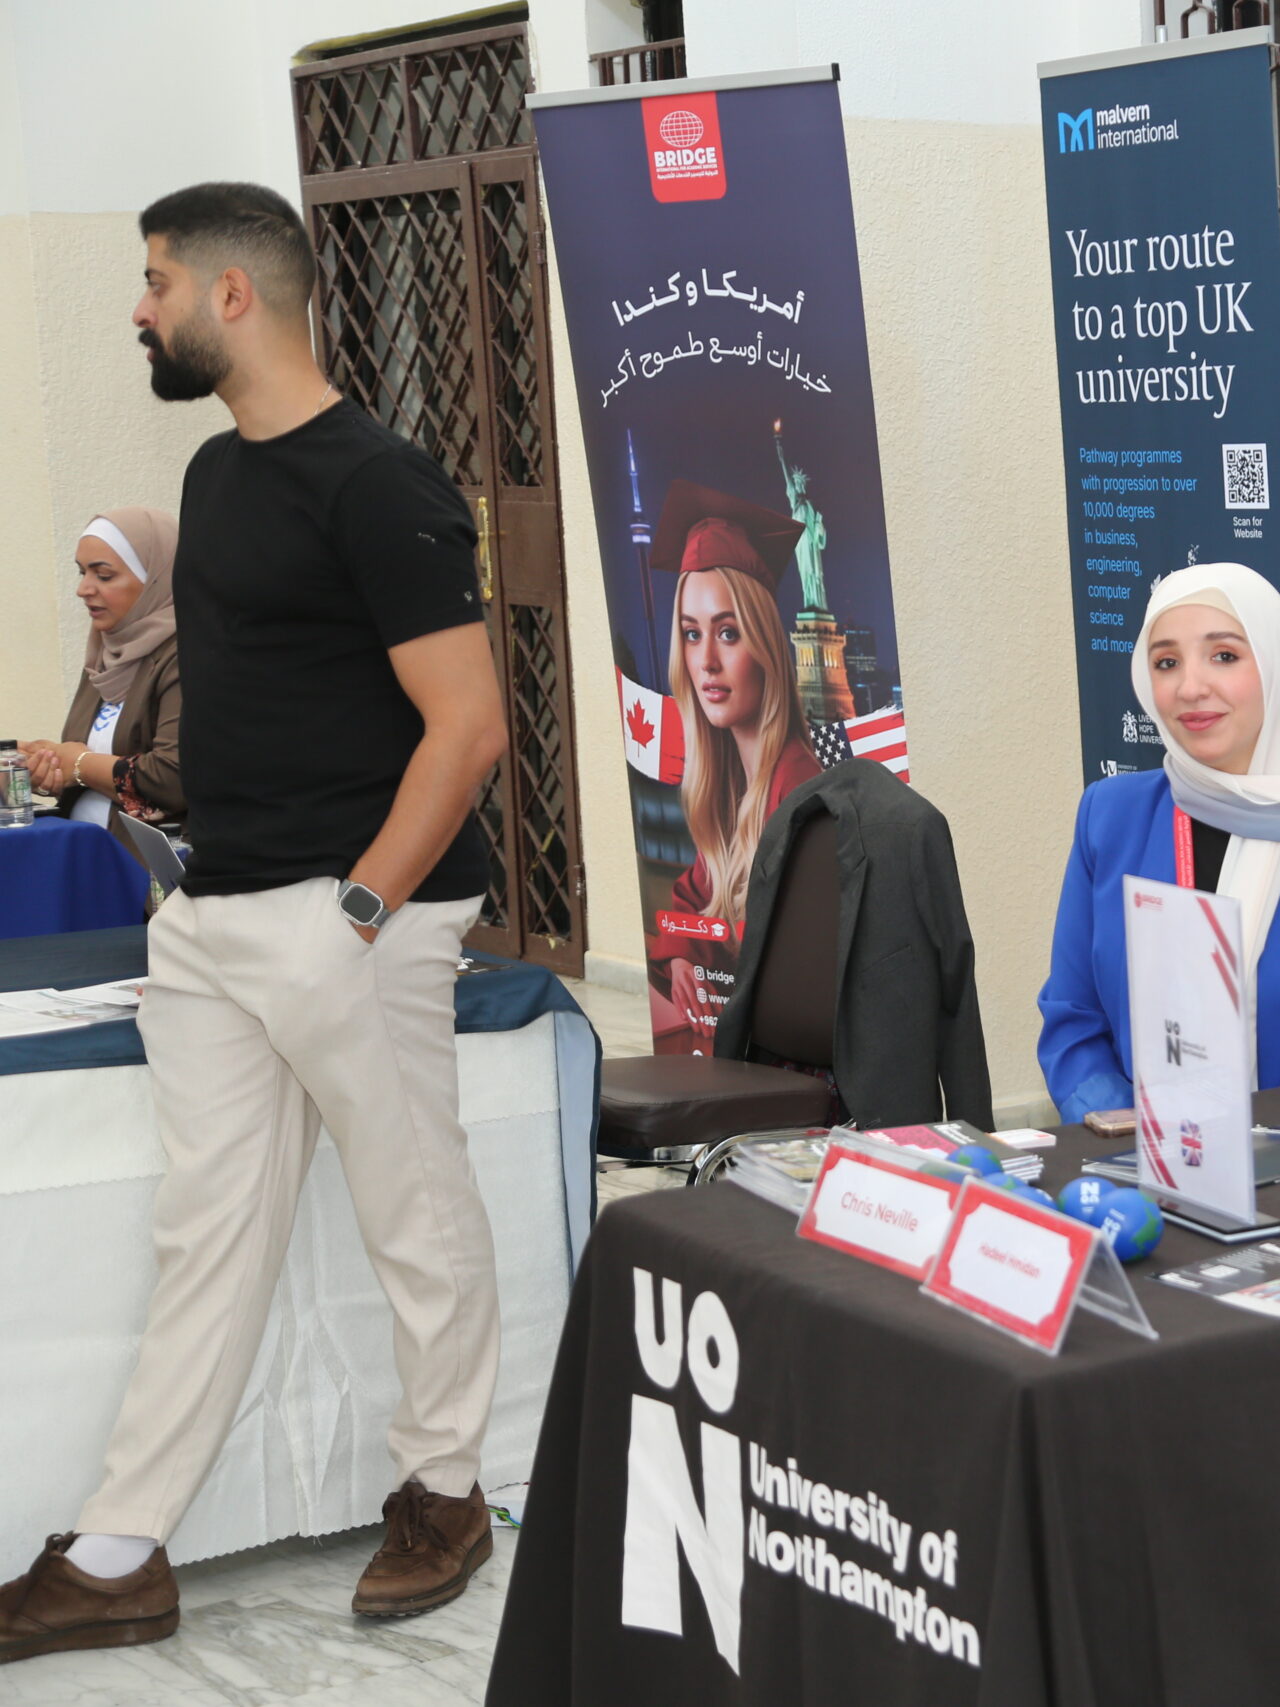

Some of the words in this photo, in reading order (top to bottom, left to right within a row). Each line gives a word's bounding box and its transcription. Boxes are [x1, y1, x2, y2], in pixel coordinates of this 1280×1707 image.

[1096, 104, 1149, 126] malvern
[1097, 120, 1178, 149] international
[654, 147, 717, 167] BRIDGE
[1066, 229, 1137, 277] Your
[1147, 225, 1235, 271] route
[703, 267, 805, 324] أمريكا
[1072, 301, 1102, 340] to
[1110, 304, 1126, 339] a
[1134, 297, 1187, 353] top
[1196, 282, 1254, 334] UK
[639, 331, 704, 378] طموح
[710, 331, 763, 363] أوسع
[601, 349, 637, 408] أكبر
[766, 347, 832, 393] خيارات
[1076, 351, 1235, 419] university
[1080, 448, 1119, 468] Pathway
[1121, 450, 1182, 467] programmes
[1081, 476, 1101, 490] with
[1103, 475, 1158, 493] progression
[1161, 478, 1171, 490] to
[1173, 479, 1197, 491] over
[1083, 501, 1113, 520] 10,000
[1116, 503, 1155, 522] degrees
[1233, 517, 1250, 527] Scan
[1252, 517, 1262, 527] for
[1084, 529, 1093, 543] in
[1095, 530, 1138, 548] business,
[1234, 529, 1263, 539] Website
[1087, 556, 1142, 576] engineering,
[1088, 586, 1131, 602] computer
[1090, 610, 1124, 626] science
[1092, 637, 1108, 651] and
[1111, 641, 1133, 653] more
[1139, 725, 1154, 734] HOPE
[661, 914, 708, 933] دكتوراه
[707, 969, 736, 987] bridge
[841, 1192, 872, 1216] Chris
[875, 1203, 918, 1231] Neville
[633, 1266, 739, 1413] UO
[749, 1441, 912, 1572] University
[919, 1529, 957, 1588] of
[622, 1393, 744, 1677] N
[749, 1505, 980, 1668] Northampton
